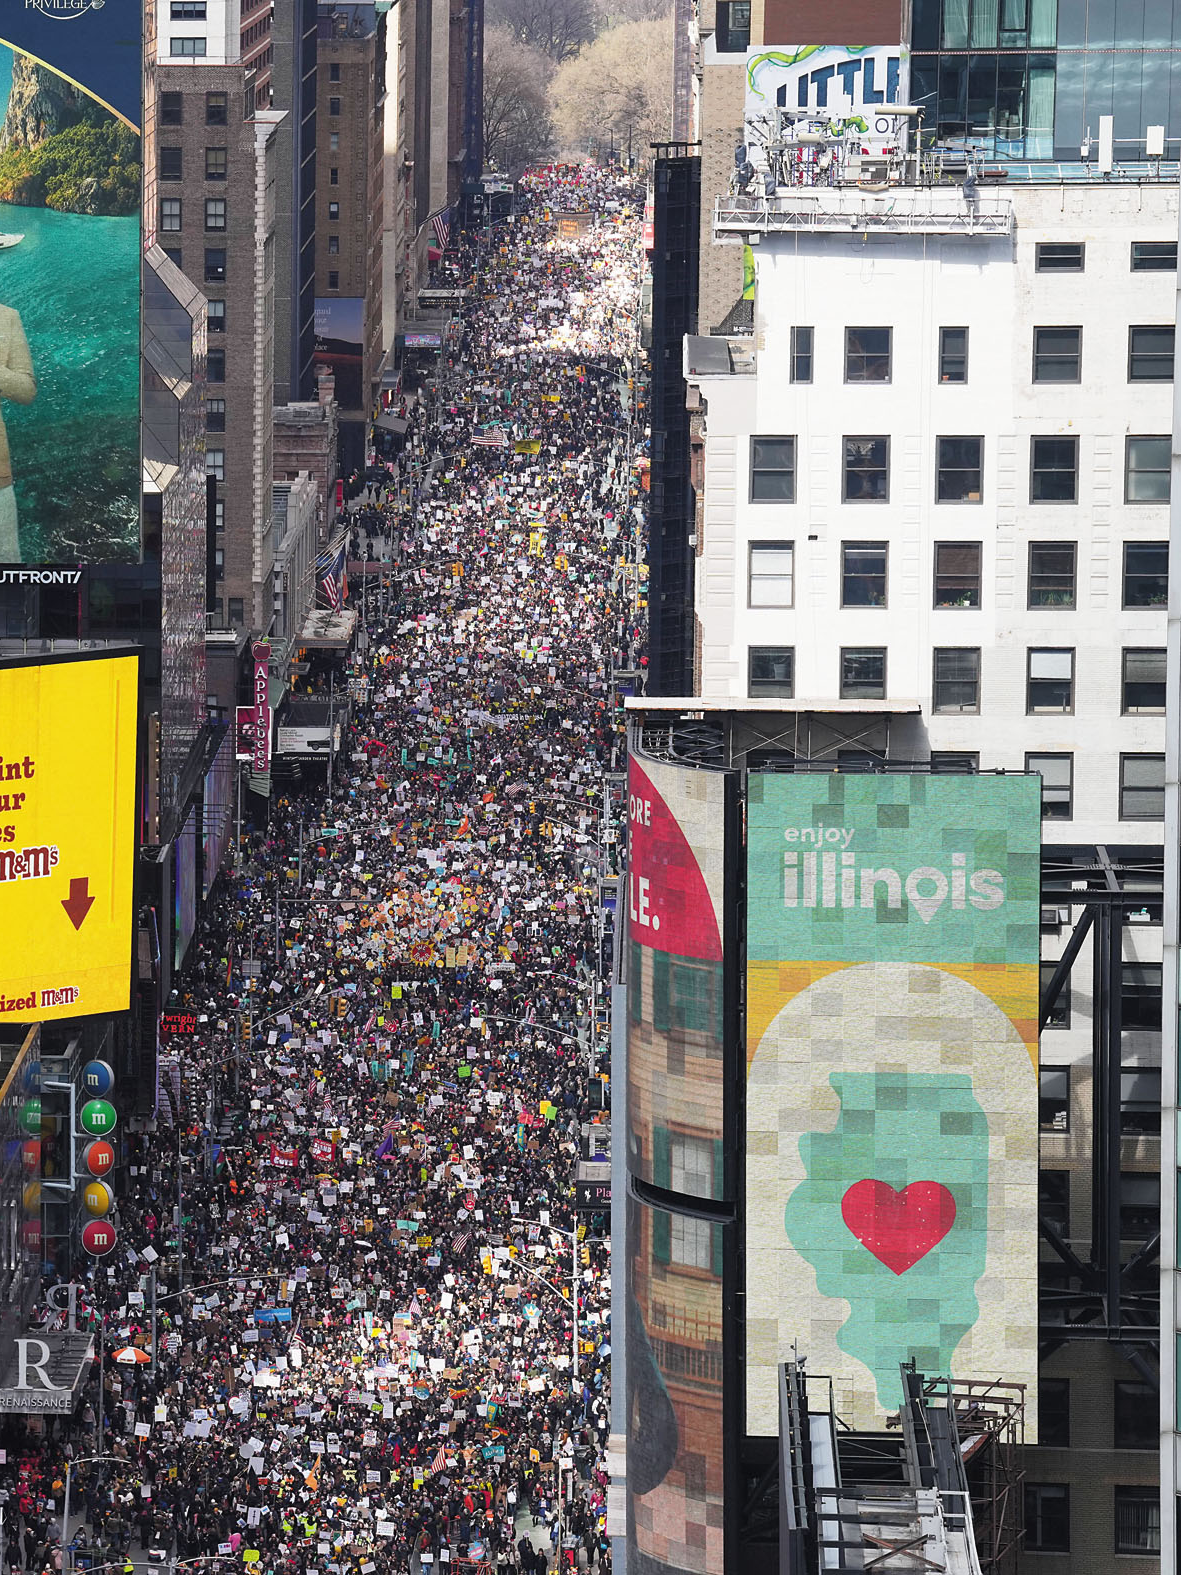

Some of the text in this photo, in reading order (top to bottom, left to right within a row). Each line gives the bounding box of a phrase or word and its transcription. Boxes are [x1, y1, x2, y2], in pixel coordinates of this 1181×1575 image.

[784, 823, 856, 848] enjoy
[784, 851, 1005, 924] illinois
[162, 1024, 195, 1033] VERN
[13, 1338, 68, 1391] R
[0, 1397, 72, 1408] RENAISSANCE
